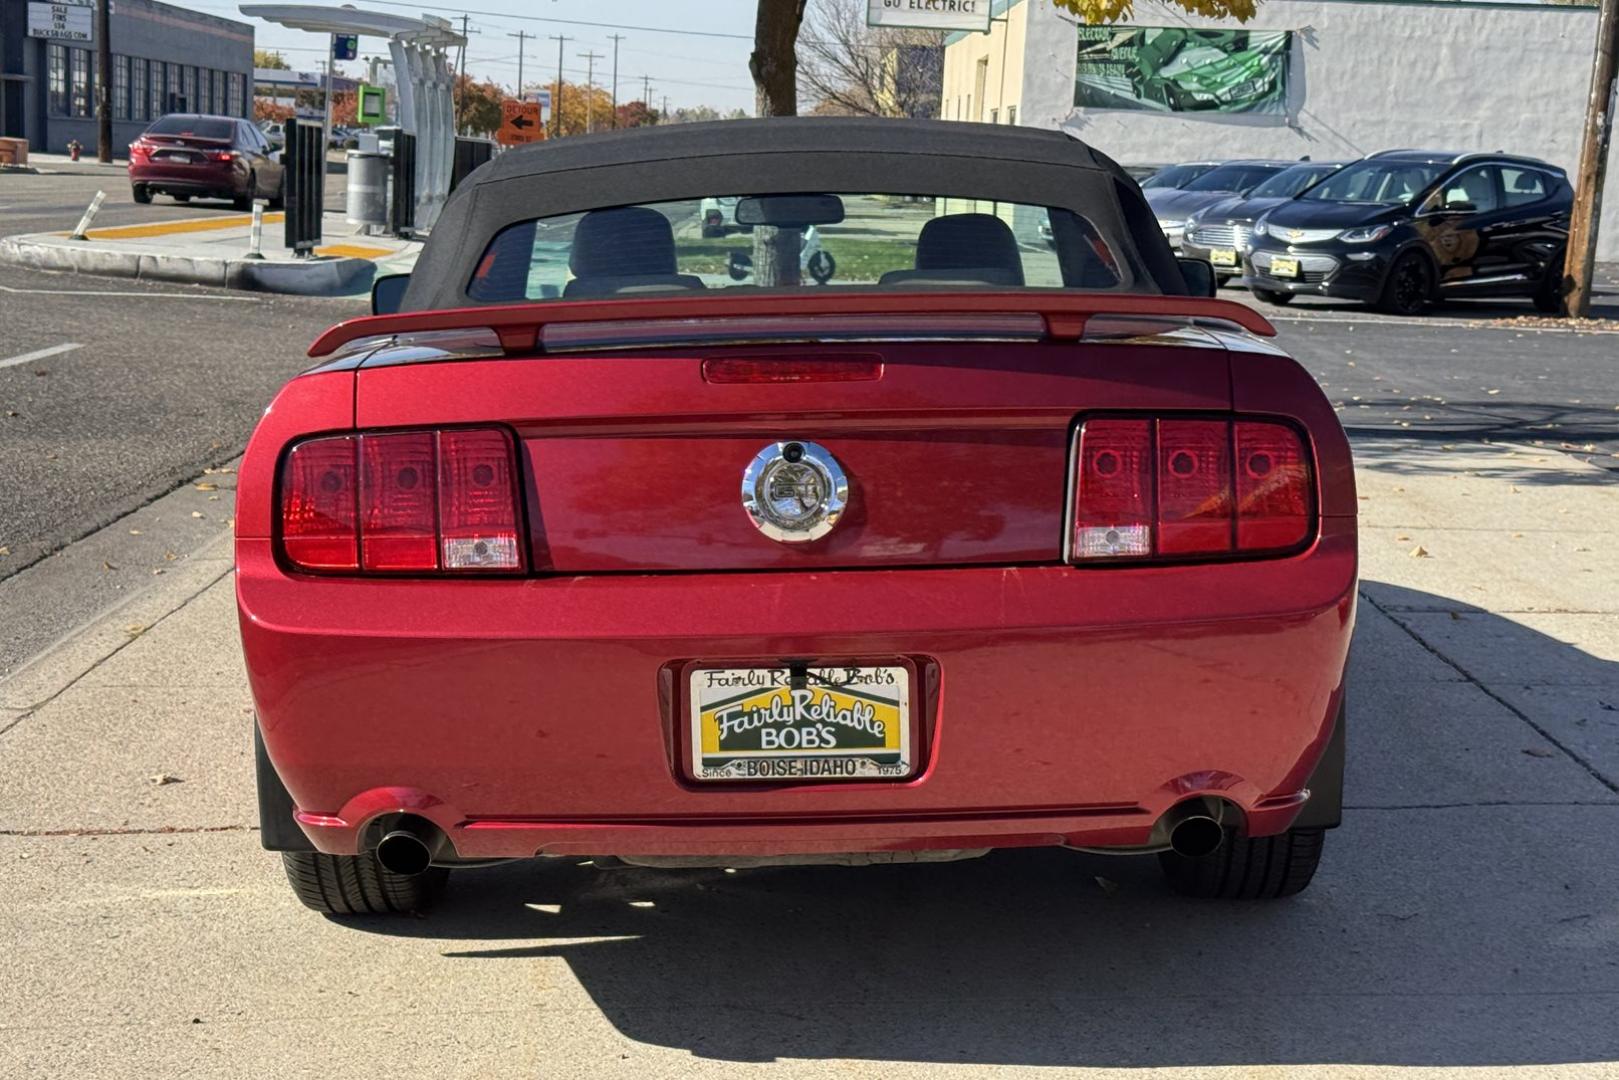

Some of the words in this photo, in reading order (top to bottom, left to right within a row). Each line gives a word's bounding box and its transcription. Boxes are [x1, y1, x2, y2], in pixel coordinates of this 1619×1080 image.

[909, 0, 976, 13] ELECTRIC!
[506, 103, 539, 116] DETOUR
[704, 669, 765, 688] Fairly
[715, 694, 794, 741] Fairly
[791, 688, 885, 738] Reliable
[760, 723, 837, 750] BOB'S
[702, 769, 732, 778] Since
